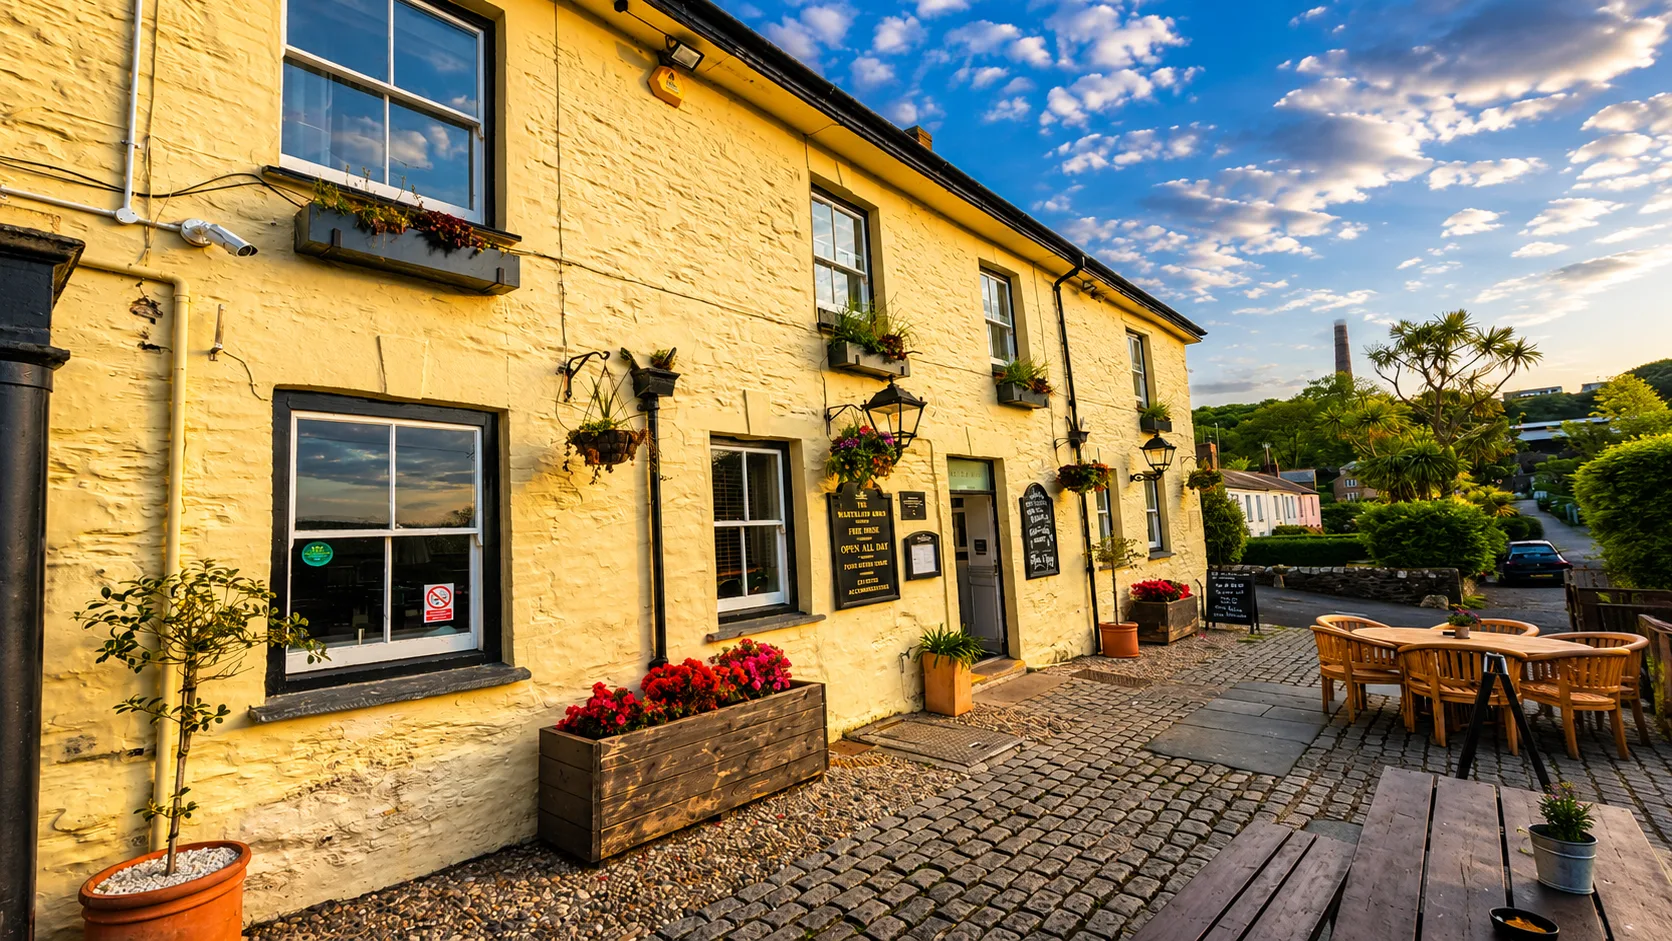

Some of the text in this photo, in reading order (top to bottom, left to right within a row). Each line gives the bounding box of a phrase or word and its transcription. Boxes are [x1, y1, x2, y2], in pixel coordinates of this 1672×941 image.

[840, 542, 889, 554] OPEN ALL DAY
